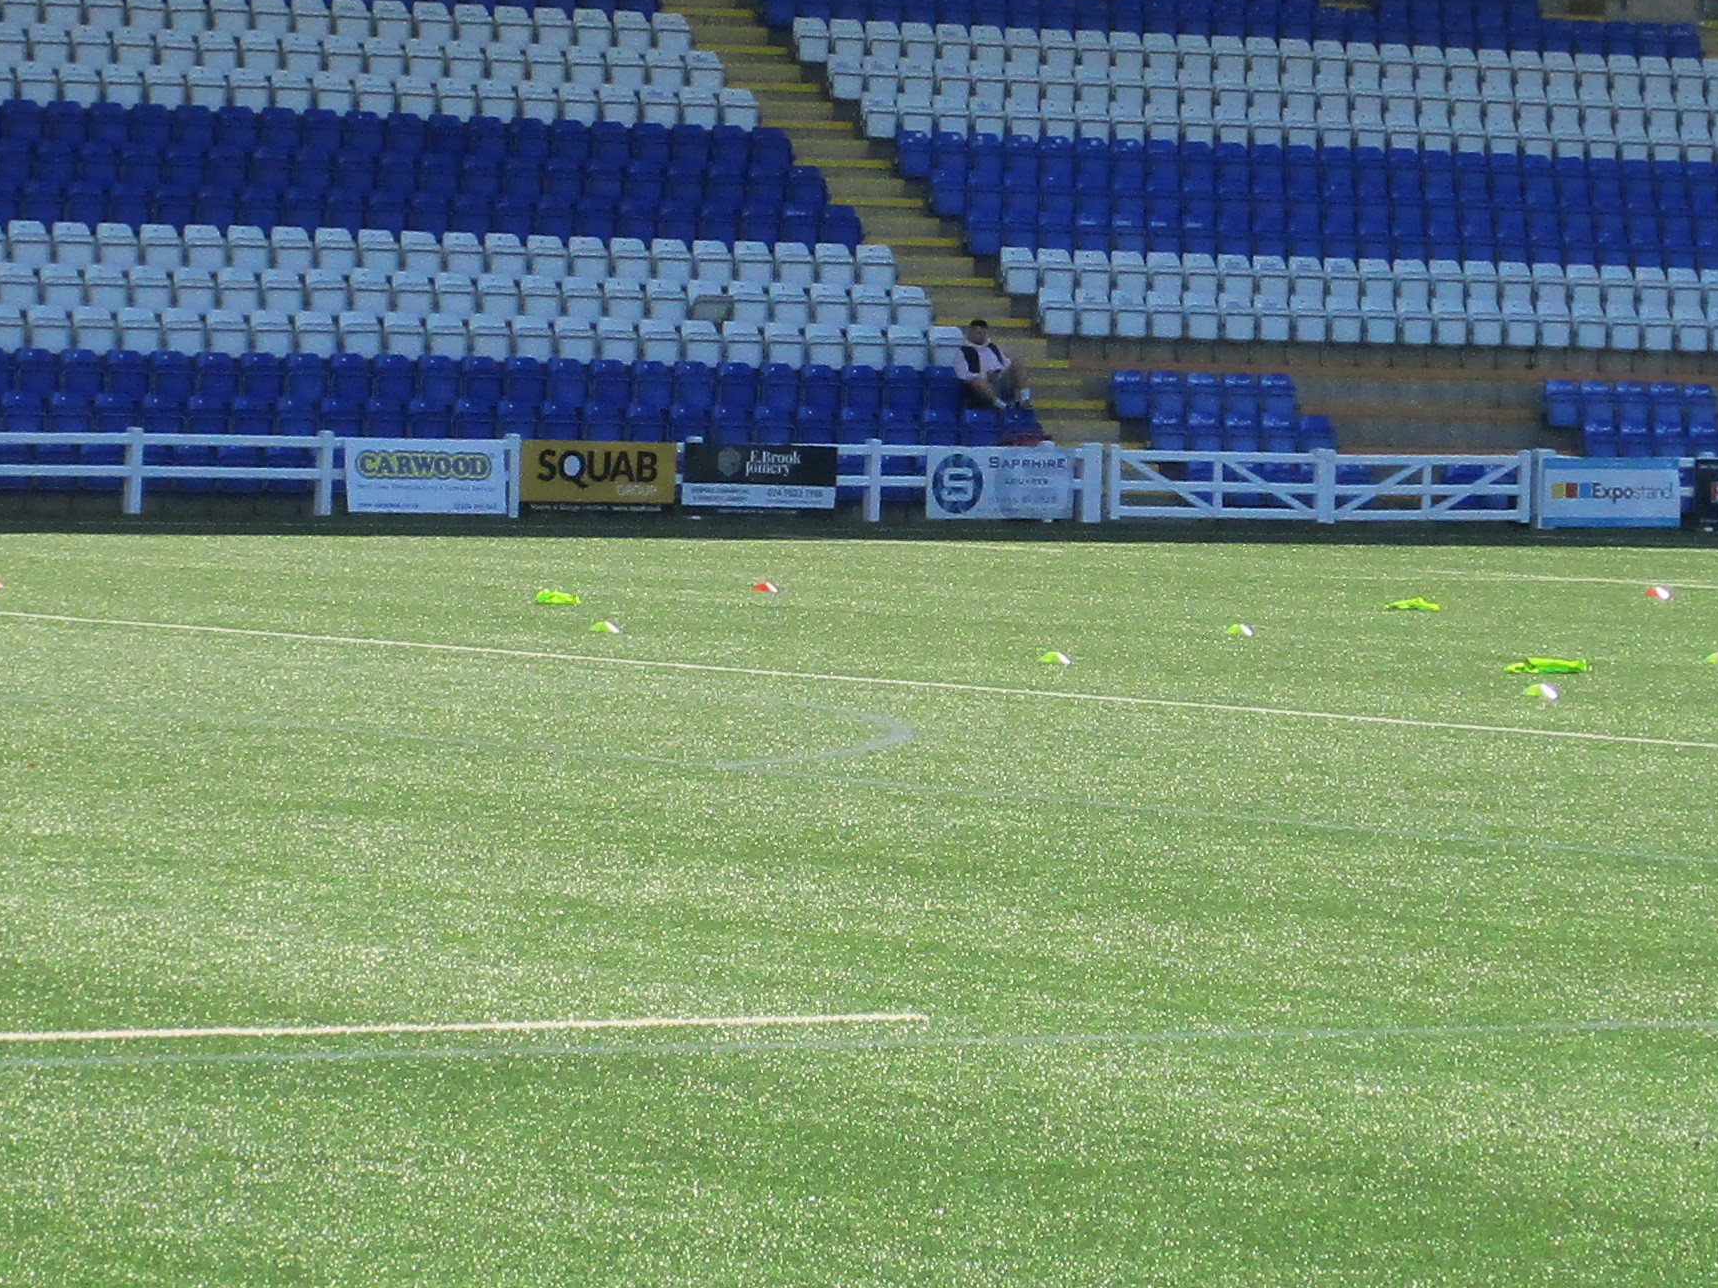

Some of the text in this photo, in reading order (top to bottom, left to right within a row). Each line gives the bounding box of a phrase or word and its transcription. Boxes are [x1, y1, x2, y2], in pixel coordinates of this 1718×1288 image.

[357, 451, 491, 479] CARWOOD
[537, 449, 658, 489] SQUAB
[1592, 483, 1674, 505] Expostand
